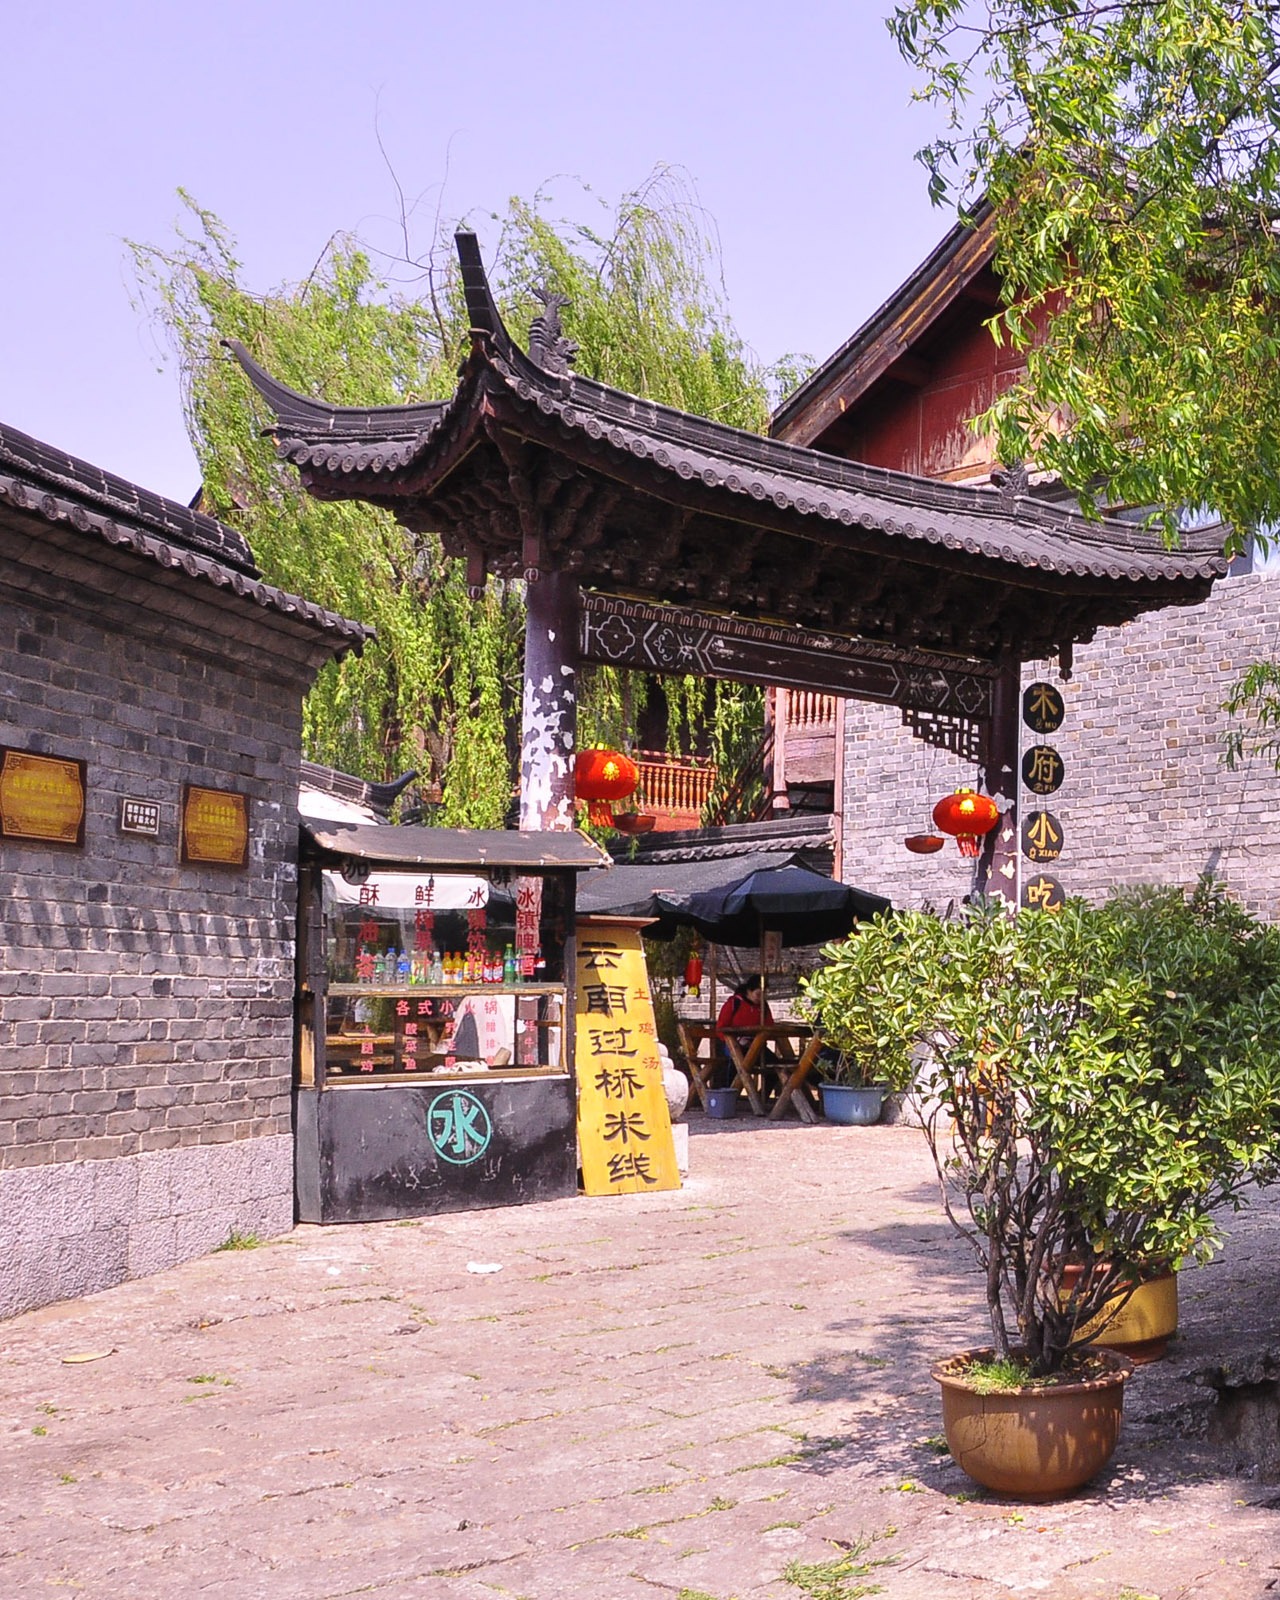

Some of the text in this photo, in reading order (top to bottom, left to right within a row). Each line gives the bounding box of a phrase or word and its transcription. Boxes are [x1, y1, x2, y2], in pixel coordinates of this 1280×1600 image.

[1027, 684, 1060, 915] 木府小吃
[1038, 849, 1059, 858] XIAO
[355, 884, 380, 978] 酥油茶
[396, 999, 498, 1016] 各式小火锅
[632, 988, 660, 1069] 土鸡汤
[577, 941, 659, 1185] 云南过桥米线
[432, 1096, 486, 1154] 水
